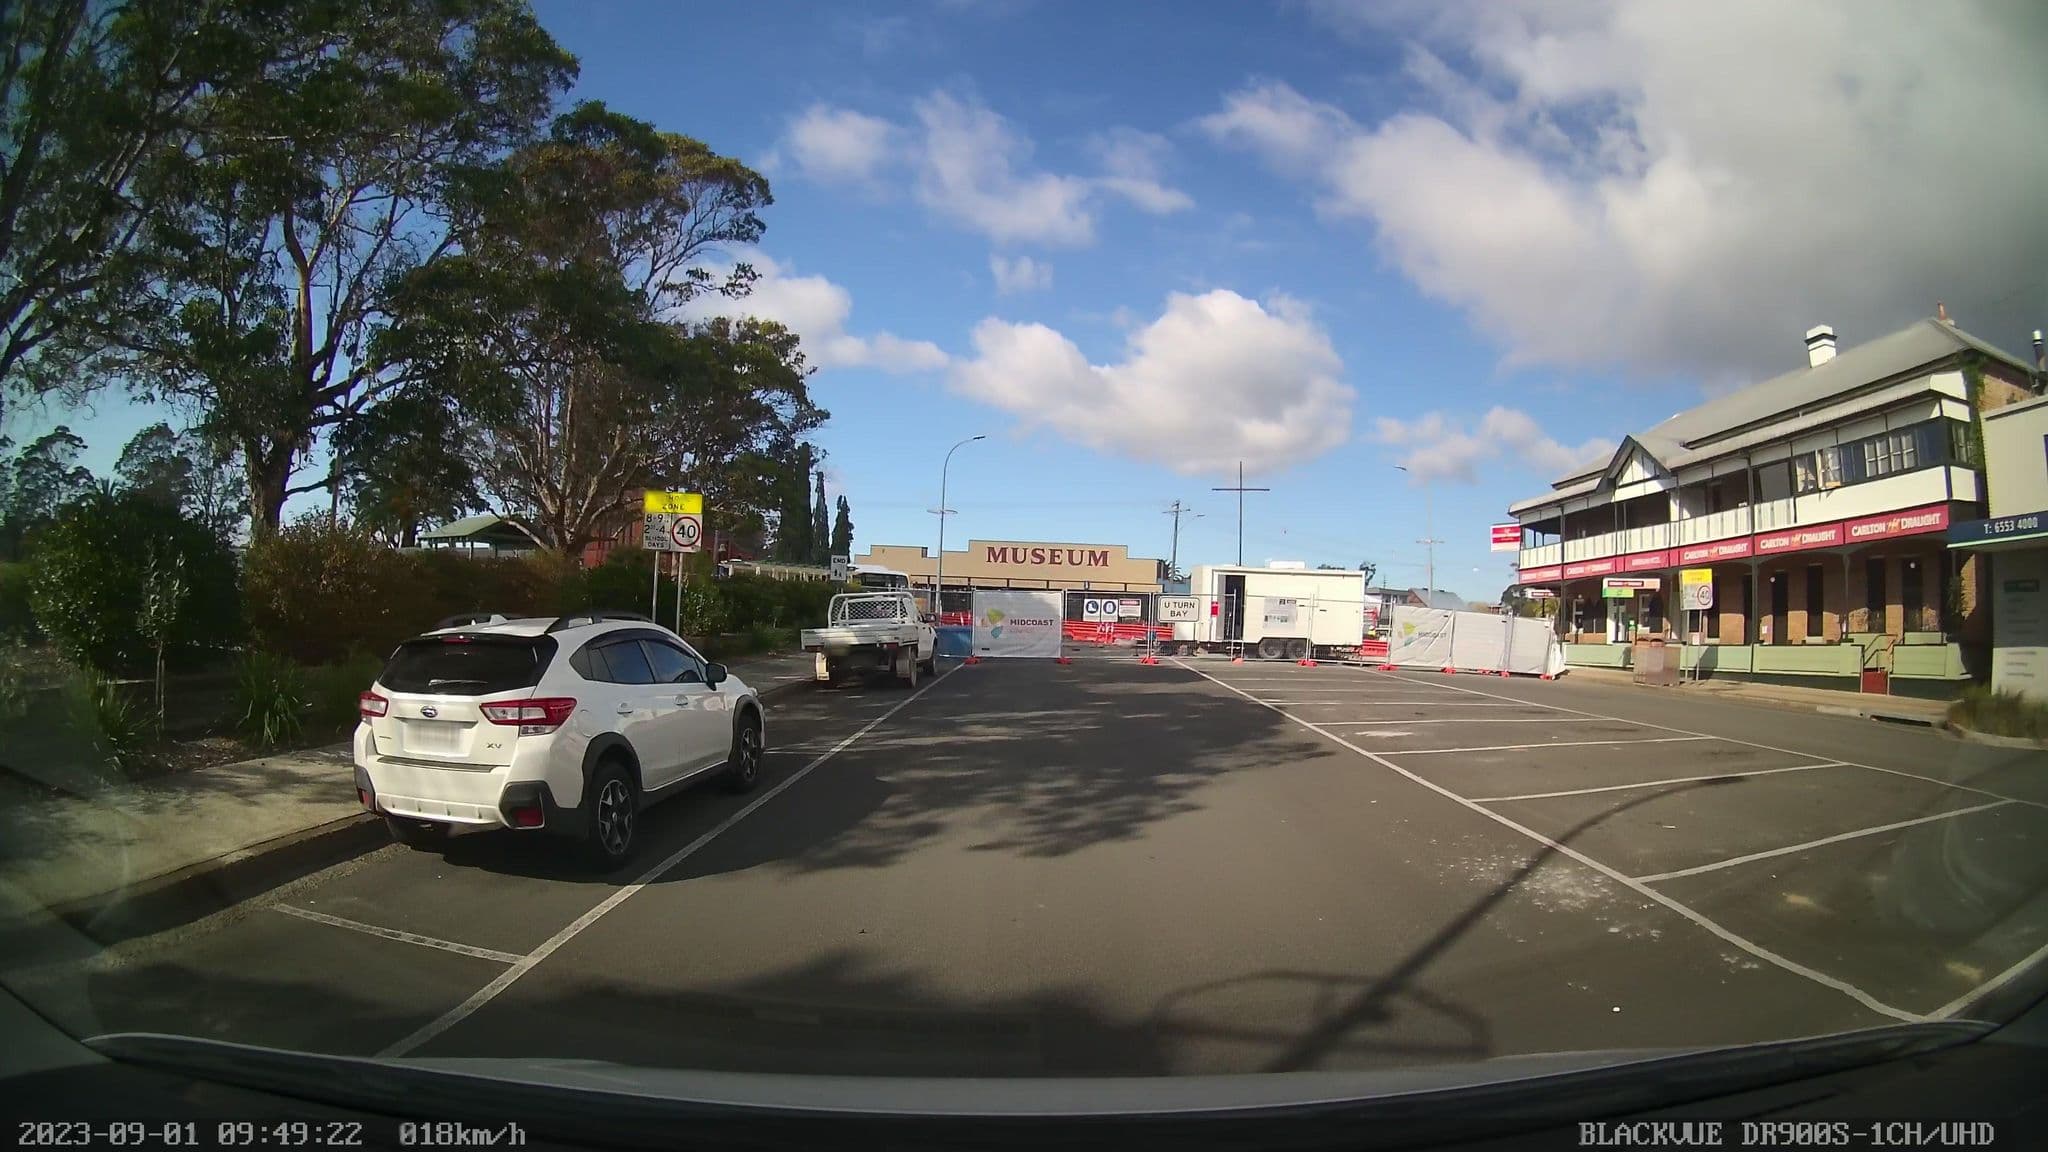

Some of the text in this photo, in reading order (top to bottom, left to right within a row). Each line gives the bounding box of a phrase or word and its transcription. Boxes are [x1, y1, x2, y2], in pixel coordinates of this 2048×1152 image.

[676, 524, 696, 538] 40
[1851, 513, 1941, 537] CARLTON DRAUGHT
[1994, 520, 2014, 533] 6553
[1760, 530, 1836, 549] CARLTON DRAUGHT
[986, 546, 1110, 567] MUSEUM
[486, 742, 502, 750] XV
